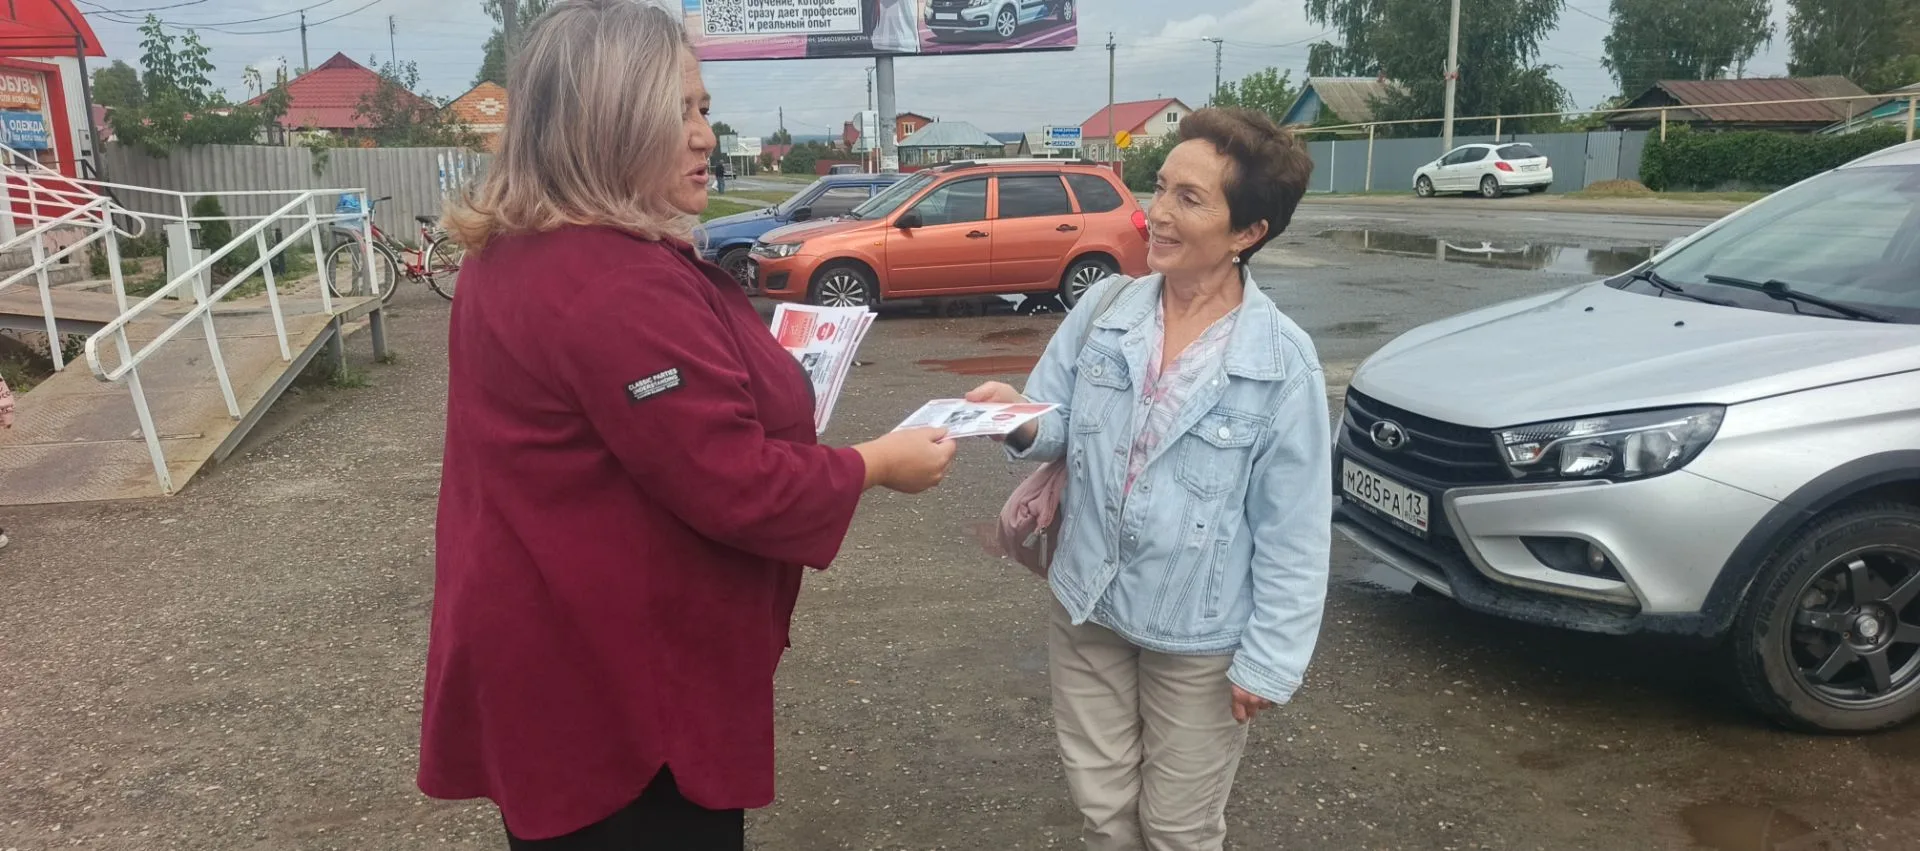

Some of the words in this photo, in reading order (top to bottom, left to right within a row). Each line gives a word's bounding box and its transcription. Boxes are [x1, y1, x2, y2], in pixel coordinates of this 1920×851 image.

[748, 9, 775, 20] сразу
[778, 8, 800, 19] дает
[802, 7, 857, 19] профессию
[749, 22, 755, 30] и
[757, 18, 805, 31] реальный
[807, 19, 832, 29] опыт
[0, 74, 38, 95] ОБУВЬ
[9, 119, 45, 133] ОДЕЖДА
[628, 377, 652, 391] CLASSIC
[653, 368, 678, 380] PARTIES
[1406, 493, 1421, 515] 13
